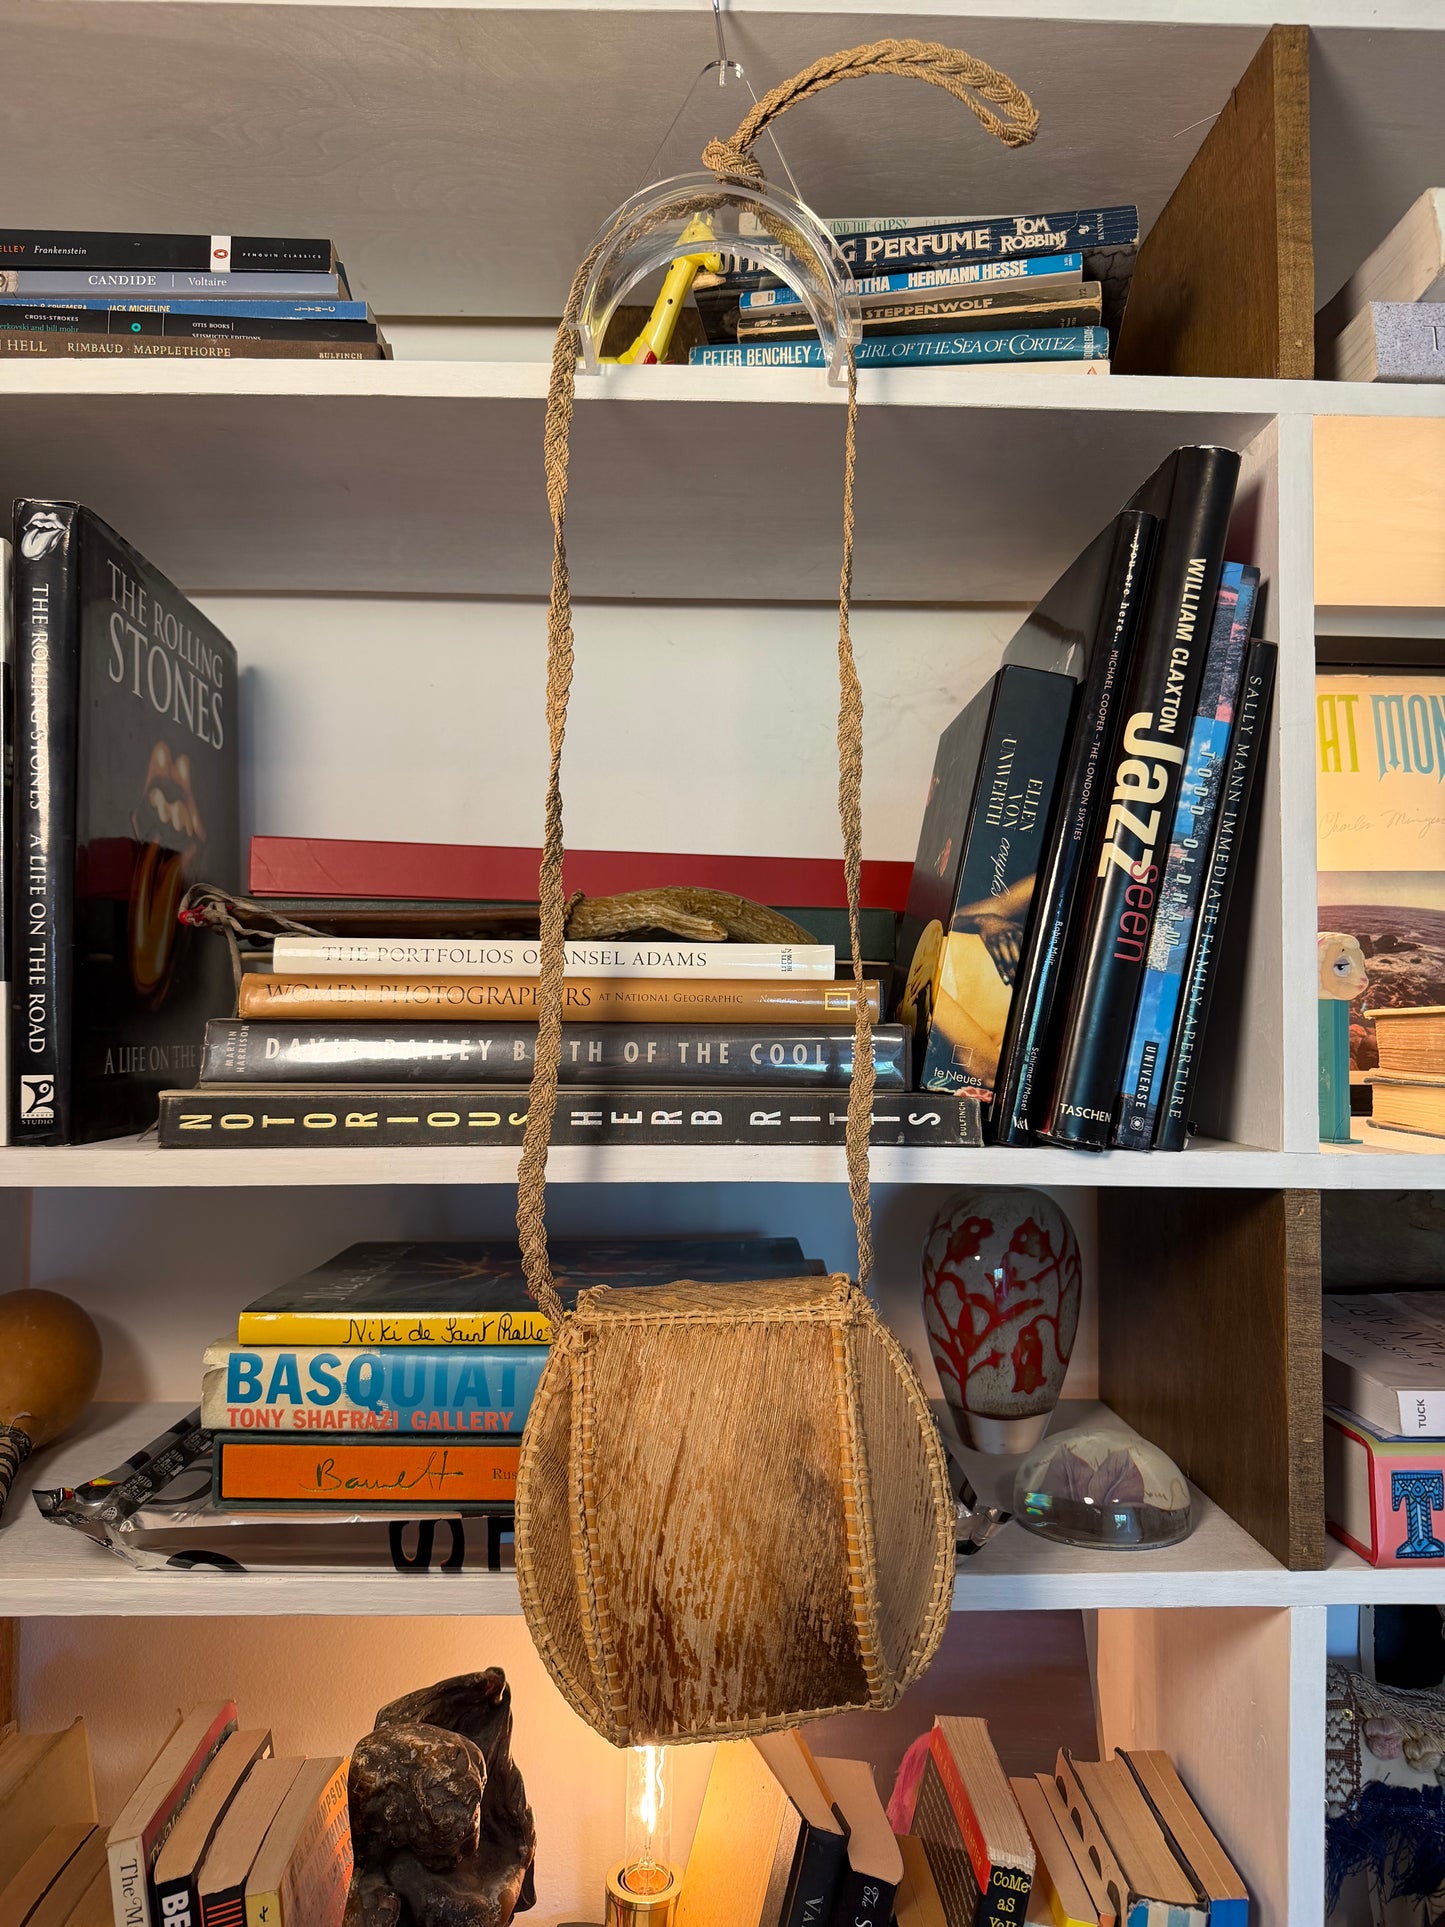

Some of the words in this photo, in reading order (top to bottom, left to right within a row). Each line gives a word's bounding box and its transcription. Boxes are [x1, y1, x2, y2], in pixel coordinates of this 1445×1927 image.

[864, 227, 992, 262] PERFUME
[1000, 231, 1067, 254] ROBBINS
[1013, 216, 1050, 236] TOM
[1097, 213, 1105, 240] BANTAM
[34, 245, 87, 255] Frankenstein
[88, 275, 157, 286] CANDIDE
[188, 277, 227, 287] Voltaire
[908, 267, 980, 288] HERMANN
[982, 259, 1028, 281] HESSE
[25, 314, 79, 322] CROSS-STROKES
[107, 304, 126, 313] JACK
[129, 305, 170, 313] MICHELINE
[865, 298, 993, 319] STEPPENWOLF
[7, 339, 48, 352] HELL
[68, 343, 123, 353] RIMBAUD
[134, 344, 231, 358] MAPPLETHORPE
[319, 352, 363, 360] BULFINCH
[703, 349, 742, 366] PETER
[747, 345, 812, 366] BENCHLEY
[853, 343, 890, 359] GIRL
[892, 343, 915, 358] OF
[915, 340, 951, 355] THE
[951, 338, 984, 354] SEA
[985, 339, 1009, 352] OF
[1008, 334, 1077, 356] CORTEZ
[32, 583, 49, 625] THE
[1175, 558, 1207, 642] WILLIAM
[107, 559, 147, 627] THE
[154, 603, 224, 690] ROLLING
[30, 632, 48, 723] ROLLING
[109, 612, 224, 750] STONES
[1104, 649, 1119, 690] MICHAEL
[1159, 648, 1190, 735] CLAXTON
[1243, 675, 1262, 736] SALLY
[1095, 693, 1110, 731] COOPER
[1090, 740, 1101, 760] THE
[1316, 694, 1361, 773] AT
[30, 731, 48, 810] STONES
[985, 737, 1017, 826] UNWERTH
[1080, 761, 1096, 805] LONDON
[1189, 750, 1217, 817] TODD
[1227, 743, 1250, 804] MANN
[1002, 793, 1023, 831] VON
[1019, 778, 1043, 834] ELLEN
[1097, 711, 1186, 886] Jazz
[29, 833, 47, 848] A
[1073, 807, 1087, 841] SIXTIES
[29, 855, 47, 897] LIFE
[990, 837, 1012, 898] couples
[1203, 810, 1238, 926] IMMEDIATE
[1166, 837, 1198, 947] OLDHAM
[29, 902, 46, 936] ON
[1114, 860, 1159, 963] seen
[29, 942, 46, 986] THE
[322, 946, 369, 963] THE
[377, 946, 514, 965] PORTFOLIOS
[523, 949, 538, 965] O
[632, 950, 708, 968] ADAMS
[1188, 933, 1214, 1006] FAMILY
[266, 983, 370, 1004] WOMEN
[378, 983, 592, 1007] PHOTOGRAPRS
[598, 993, 612, 1001] AT
[615, 992, 668, 1002] NATIONAL
[673, 993, 744, 1004] GEOGRAPHIC
[29, 992, 46, 1054] ROAD
[104, 1047, 116, 1075] A
[119, 1046, 147, 1074] LIFE
[150, 1045, 169, 1072] ON
[172, 1044, 196, 1069] THE
[225, 1030, 237, 1070] MARTIN
[236, 1024, 250, 1074] HARRISON
[265, 1038, 360, 1061] DAVID
[384, 1039, 493, 1062] BAILEY
[513, 1040, 602, 1062] BTH
[624, 1041, 657, 1064] OF
[679, 1041, 730, 1064] THE
[750, 1043, 826, 1065] COOL
[1169, 1016, 1197, 1119] APERTURE
[1136, 1045, 1157, 1108] UNIVERSE
[179, 1111, 528, 1130] NOTORIOUS
[570, 1109, 723, 1127] HERB
[958, 1101, 967, 1136] BULFINCH
[1059, 1103, 1112, 1123] TASCHEN
[342, 1317, 402, 1344] Niki
[409, 1320, 434, 1342] de
[441, 1316, 494, 1344] Saint
[497, 1313, 549, 1343] Phalle
[226, 1352, 527, 1409] BASQUIAT
[227, 1408, 284, 1428] TONY
[293, 1409, 398, 1430] SHAFRAZI
[412, 1411, 514, 1431] GALLERY
[1417, 1398, 1427, 1428] TUCK
[492, 1468, 518, 1480] Rus
[120, 1858, 138, 1898] The
[125, 1896, 144, 1927] M
[802, 1895, 824, 1927] VA
[997, 1898, 1016, 1912] aS
